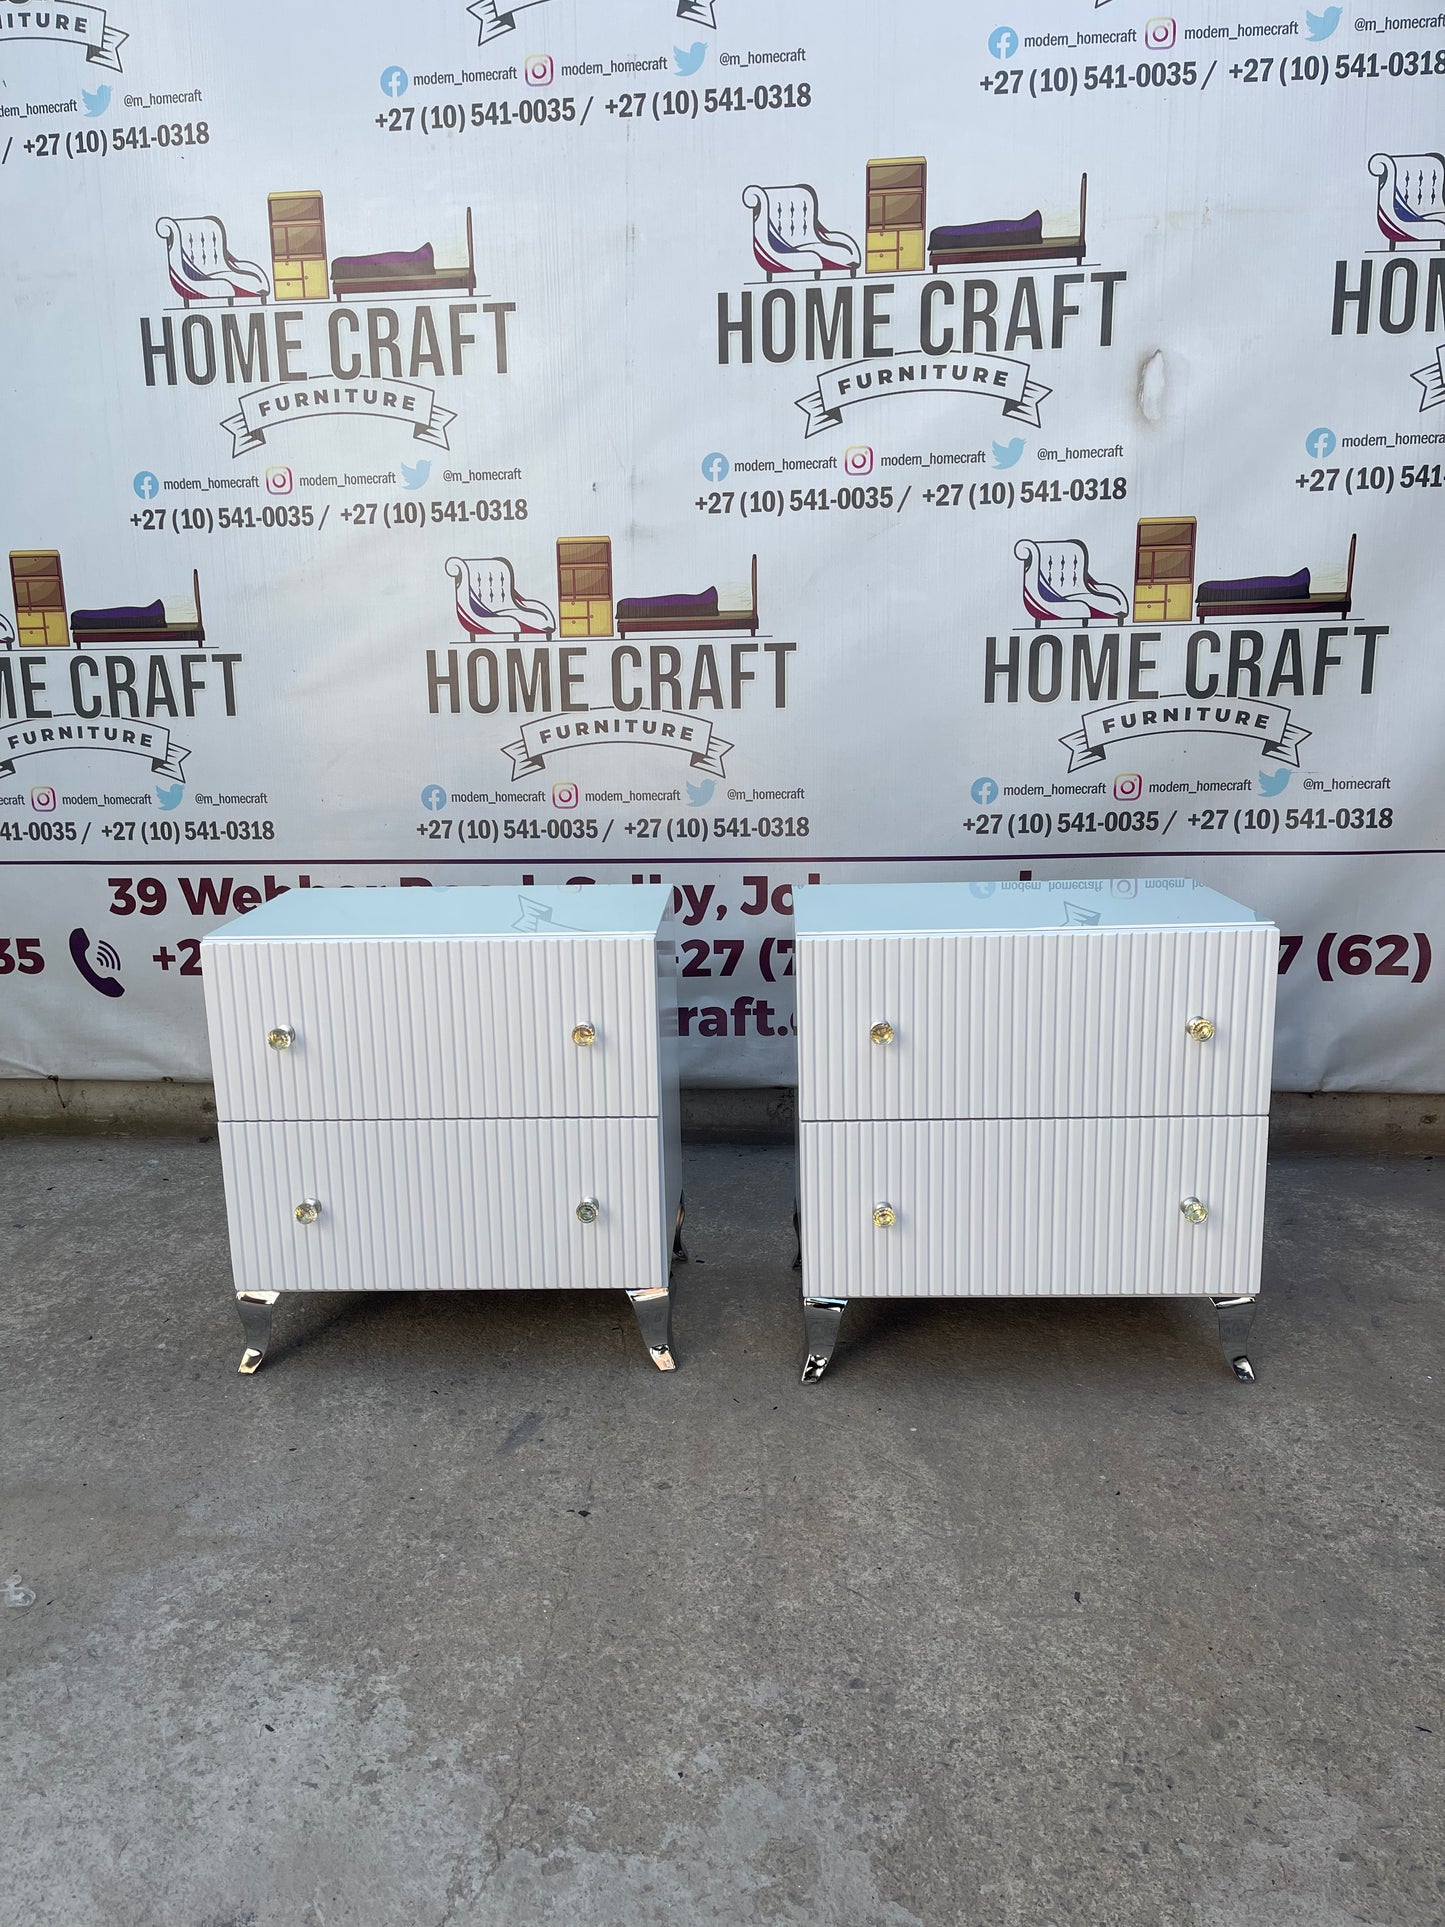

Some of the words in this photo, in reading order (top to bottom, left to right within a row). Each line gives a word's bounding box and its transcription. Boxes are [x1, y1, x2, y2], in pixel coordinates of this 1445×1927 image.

[0, 12, 88, 34] ITURE
[1354, 13, 1445, 34] @m_homecraft
[719, 47, 807, 68] @m_homecraft
[979, 69, 1024, 95] +27
[1029, 66, 1078, 99] (10)
[1083, 61, 1197, 91] 541-0035
[1228, 57, 1274, 83] +27
[1279, 55, 1329, 87] (10)
[1334, 49, 1445, 79] 541-0318
[123, 88, 203, 109] @m_homecraft
[375, 107, 415, 132] +27
[420, 104, 466, 136] (10)
[470, 97, 576, 127] 541-0035
[604, 92, 647, 118] +27
[652, 89, 699, 122] (10)
[703, 82, 812, 113] 541-0318
[23, 133, 61, 157] +27
[65, 129, 108, 160] (10)
[112, 121, 210, 151] 541-0318
[717, 284, 895, 365] HOME
[920, 271, 1128, 356] CRAFT
[140, 311, 308, 387] HOME
[328, 302, 516, 382] CRAFT
[838, 364, 1009, 396] FURNITURE
[258, 388, 416, 418] FURNITURE
[1037, 444, 1124, 463] @m_homecraft
[442, 467, 522, 484] @m_homecraft
[1295, 468, 1341, 492] +27
[1345, 465, 1395, 496] (10)
[1399, 464, 1445, 489] 541
[694, 491, 735, 514] +27
[740, 490, 785, 518] (10)
[789, 486, 894, 512] 541-0035
[922, 483, 964, 507] +27
[968, 481, 1015, 511] (10)
[1020, 476, 1127, 504] 541-0318
[129, 508, 167, 531] +27
[172, 507, 214, 535] (10)
[218, 505, 314, 529] 541-0035
[340, 503, 378, 525] +27
[383, 501, 426, 529] (10)
[430, 498, 529, 523] 541-0318
[426, 647, 592, 716] HOME
[609, 640, 796, 713] CRAFT
[985, 633, 1163, 705] HOME
[1183, 624, 1389, 701] CRAFT
[67, 654, 242, 721] CRAFT
[539, 719, 695, 744] FURNITURE
[1102, 707, 1271, 734] FURNITURE
[8, 726, 153, 750] FURNITURE
[194, 792, 269, 807] @m_homecraft
[726, 787, 805, 803] @m_homecraft
[1303, 776, 1392, 793] @m_homecraft
[101, 821, 136, 841] +27
[141, 821, 181, 846] (10)
[184, 820, 275, 841] 541-0318
[416, 819, 453, 840] +27
[458, 819, 499, 844] (10)
[503, 818, 599, 840] 541-0035
[624, 818, 662, 839] +27
[666, 817, 709, 843] (10)
[712, 816, 810, 838] 541-0318
[962, 813, 1003, 835] +27
[1007, 813, 1052, 839] (10)
[1057, 810, 1159, 834] 541-0035
[1187, 809, 1229, 830] +27
[1233, 808, 1280, 835] (10)
[1284, 807, 1394, 830] 541-0318
[108, 878, 166, 915] 39
[676, 939, 744, 977] 27
[1317, 933, 1431, 983] (62)
[677, 996, 796, 1038] raft.
